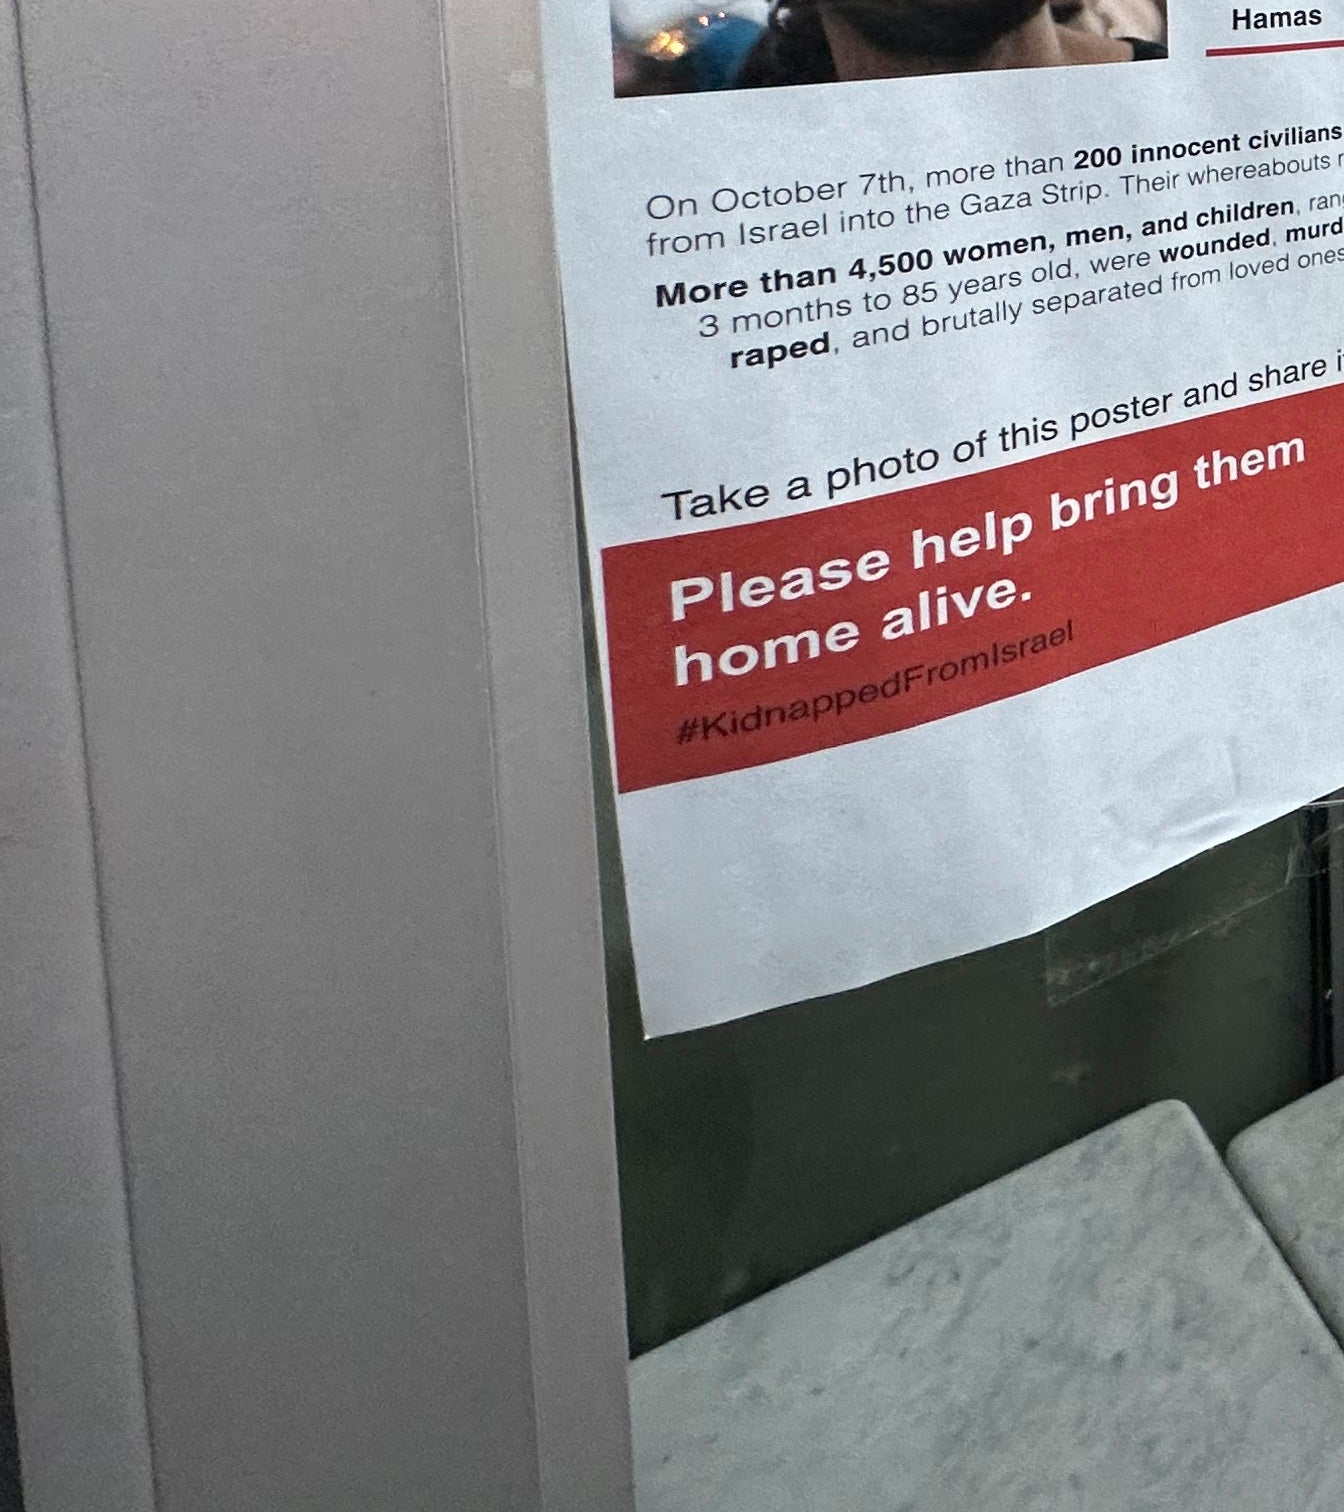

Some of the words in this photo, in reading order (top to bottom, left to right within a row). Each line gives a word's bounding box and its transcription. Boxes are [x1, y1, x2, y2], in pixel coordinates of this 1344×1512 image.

[1232, 8, 1322, 30] Hamas
[647, 194, 698, 220] On
[711, 179, 848, 214] October
[859, 171, 915, 196] 7th,
[926, 161, 996, 188] more
[1005, 154, 1065, 179] than
[1073, 146, 1122, 171] 200
[1131, 131, 1241, 165] innocent
[1248, 122, 1343, 152] civilians
[647, 232, 725, 257] from
[738, 213, 828, 247] Israel
[840, 206, 895, 233] into
[905, 199, 950, 224] the
[959, 186, 1033, 217] Gaza
[1041, 179, 1111, 206] Strip.
[1120, 171, 1180, 197] Their
[1187, 153, 1331, 187] whereabouts
[655, 279, 749, 308] More
[760, 265, 837, 295] than
[848, 248, 934, 283] 4,500
[943, 234, 1056, 266] women,
[1065, 223, 1132, 248] men,
[1141, 211, 1189, 236] and
[1196, 198, 1301, 228] children,
[699, 314, 719, 337] 3
[732, 297, 852, 334] months
[863, 291, 891, 312] to
[902, 281, 938, 306] 85
[947, 271, 1022, 304] years
[1031, 256, 1080, 284] old,
[1089, 249, 1152, 275] were
[1159, 229, 1277, 265] wounded,
[730, 332, 839, 369] raped,
[852, 319, 910, 348] and
[921, 300, 1022, 337] brutally
[1032, 275, 1163, 315] separated
[1170, 268, 1222, 291] from
[1229, 253, 1290, 281] loved
[661, 483, 770, 521] Take
[786, 475, 813, 500] a
[827, 448, 940, 499] photo
[952, 430, 987, 464] of
[998, 417, 1059, 452] this
[1071, 390, 1174, 441] poster
[1184, 373, 1238, 408] and
[1248, 356, 1328, 390] share
[670, 548, 890, 622] Please
[911, 509, 1034, 570] help
[1050, 469, 1179, 531] bring
[1193, 437, 1307, 489] them
[674, 620, 860, 687] home
[881, 577, 1032, 641] alive.
[677, 620, 1074, 745] #KidnappedFromIsrael
